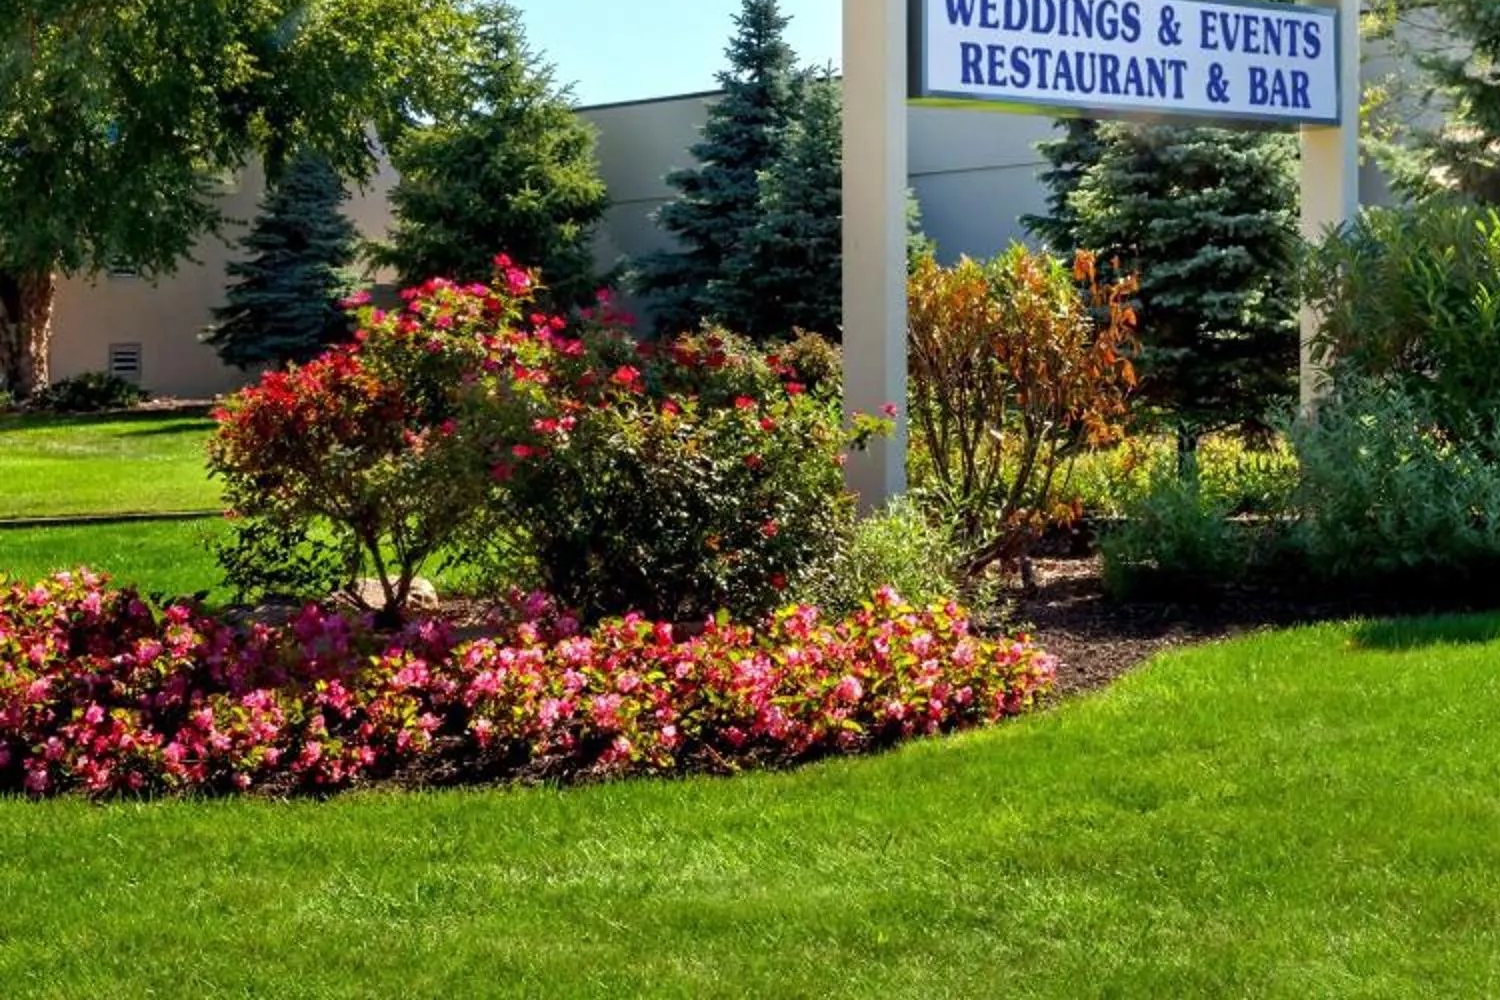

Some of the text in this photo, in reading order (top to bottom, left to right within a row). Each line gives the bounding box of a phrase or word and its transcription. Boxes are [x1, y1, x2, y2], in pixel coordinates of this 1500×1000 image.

[1158, 5, 1182, 46] &
[1200, 10, 1321, 59] EVENTS
[960, 42, 1311, 109] RESTAURANT & BAR
